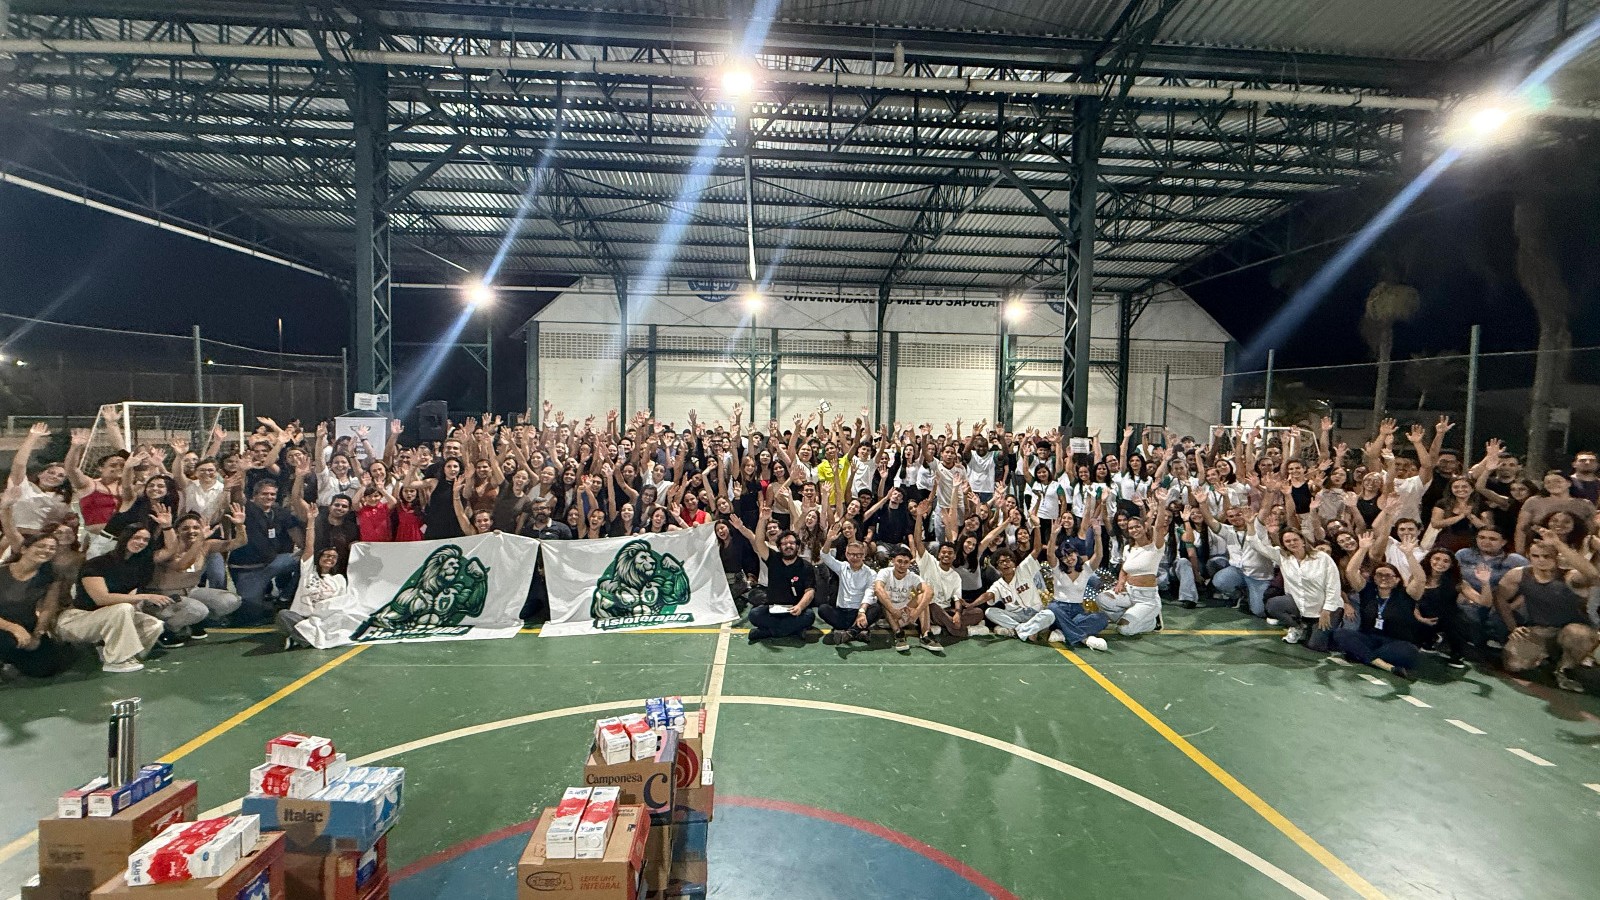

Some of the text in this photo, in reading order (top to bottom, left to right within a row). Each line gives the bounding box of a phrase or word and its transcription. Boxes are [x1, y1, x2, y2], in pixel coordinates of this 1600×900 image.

[596, 613, 690, 628] Fisioterapia
[586, 772, 668, 809] Camponesa C
[283, 808, 324, 822] Italac
[580, 882, 621, 890] INTEGRAL
